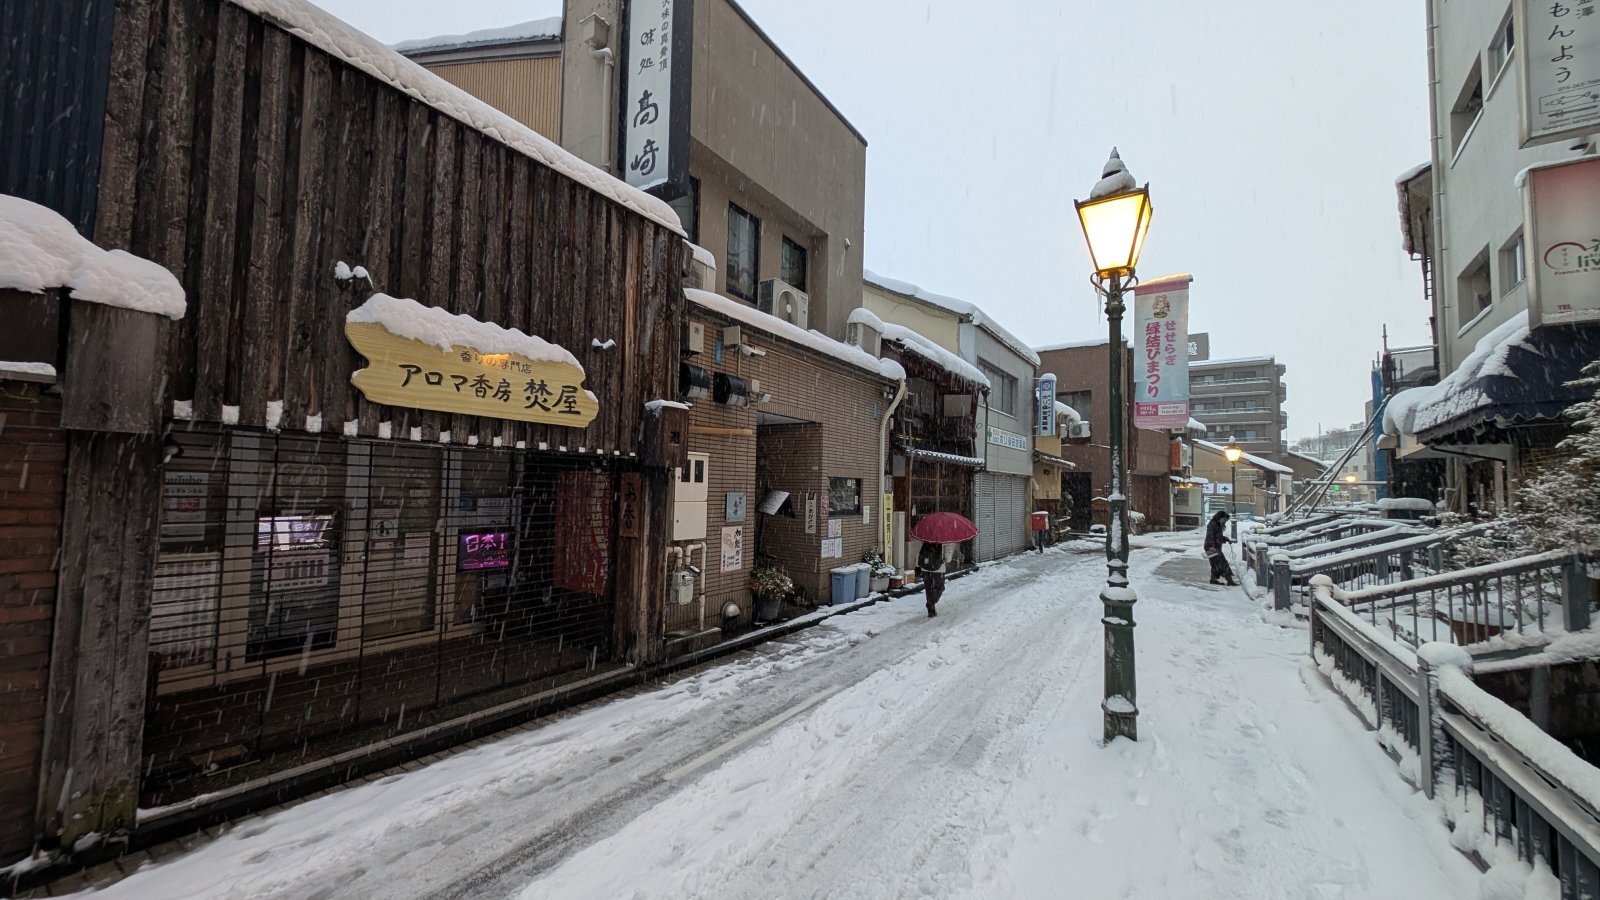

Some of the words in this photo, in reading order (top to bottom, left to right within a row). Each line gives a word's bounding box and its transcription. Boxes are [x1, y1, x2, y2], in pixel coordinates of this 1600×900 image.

[1145, 322, 1161, 398] 縁結びまつり
[1164, 320, 1177, 366] せせらぎ
[398, 363, 513, 403] アロマ香房
[523, 378, 582, 416] 焚屋
